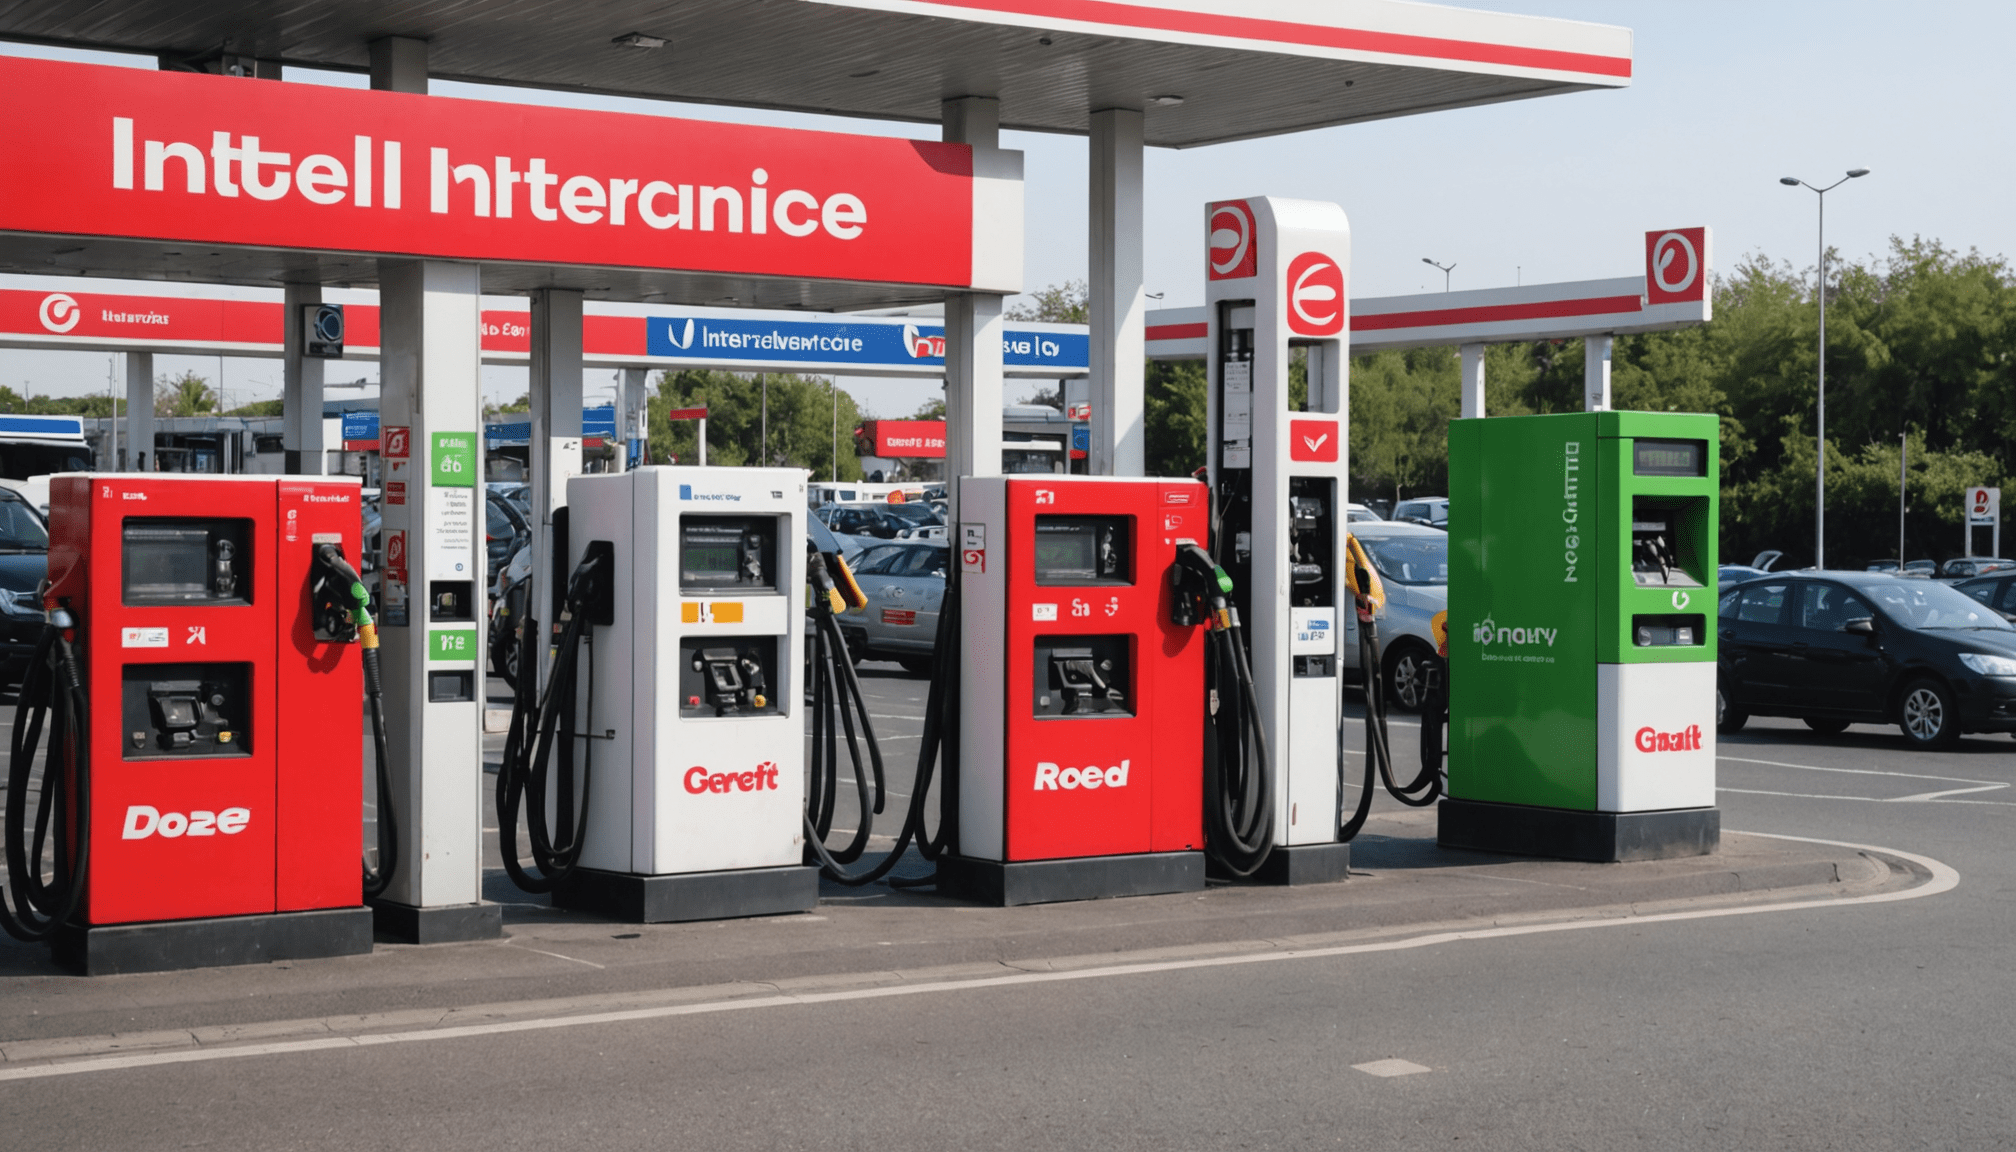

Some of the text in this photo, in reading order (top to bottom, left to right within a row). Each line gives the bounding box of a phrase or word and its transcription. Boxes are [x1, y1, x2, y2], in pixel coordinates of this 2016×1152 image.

[113, 116, 401, 210] Inttell
[1033, 759, 1130, 791] Roed
[121, 805, 251, 840] Doze
